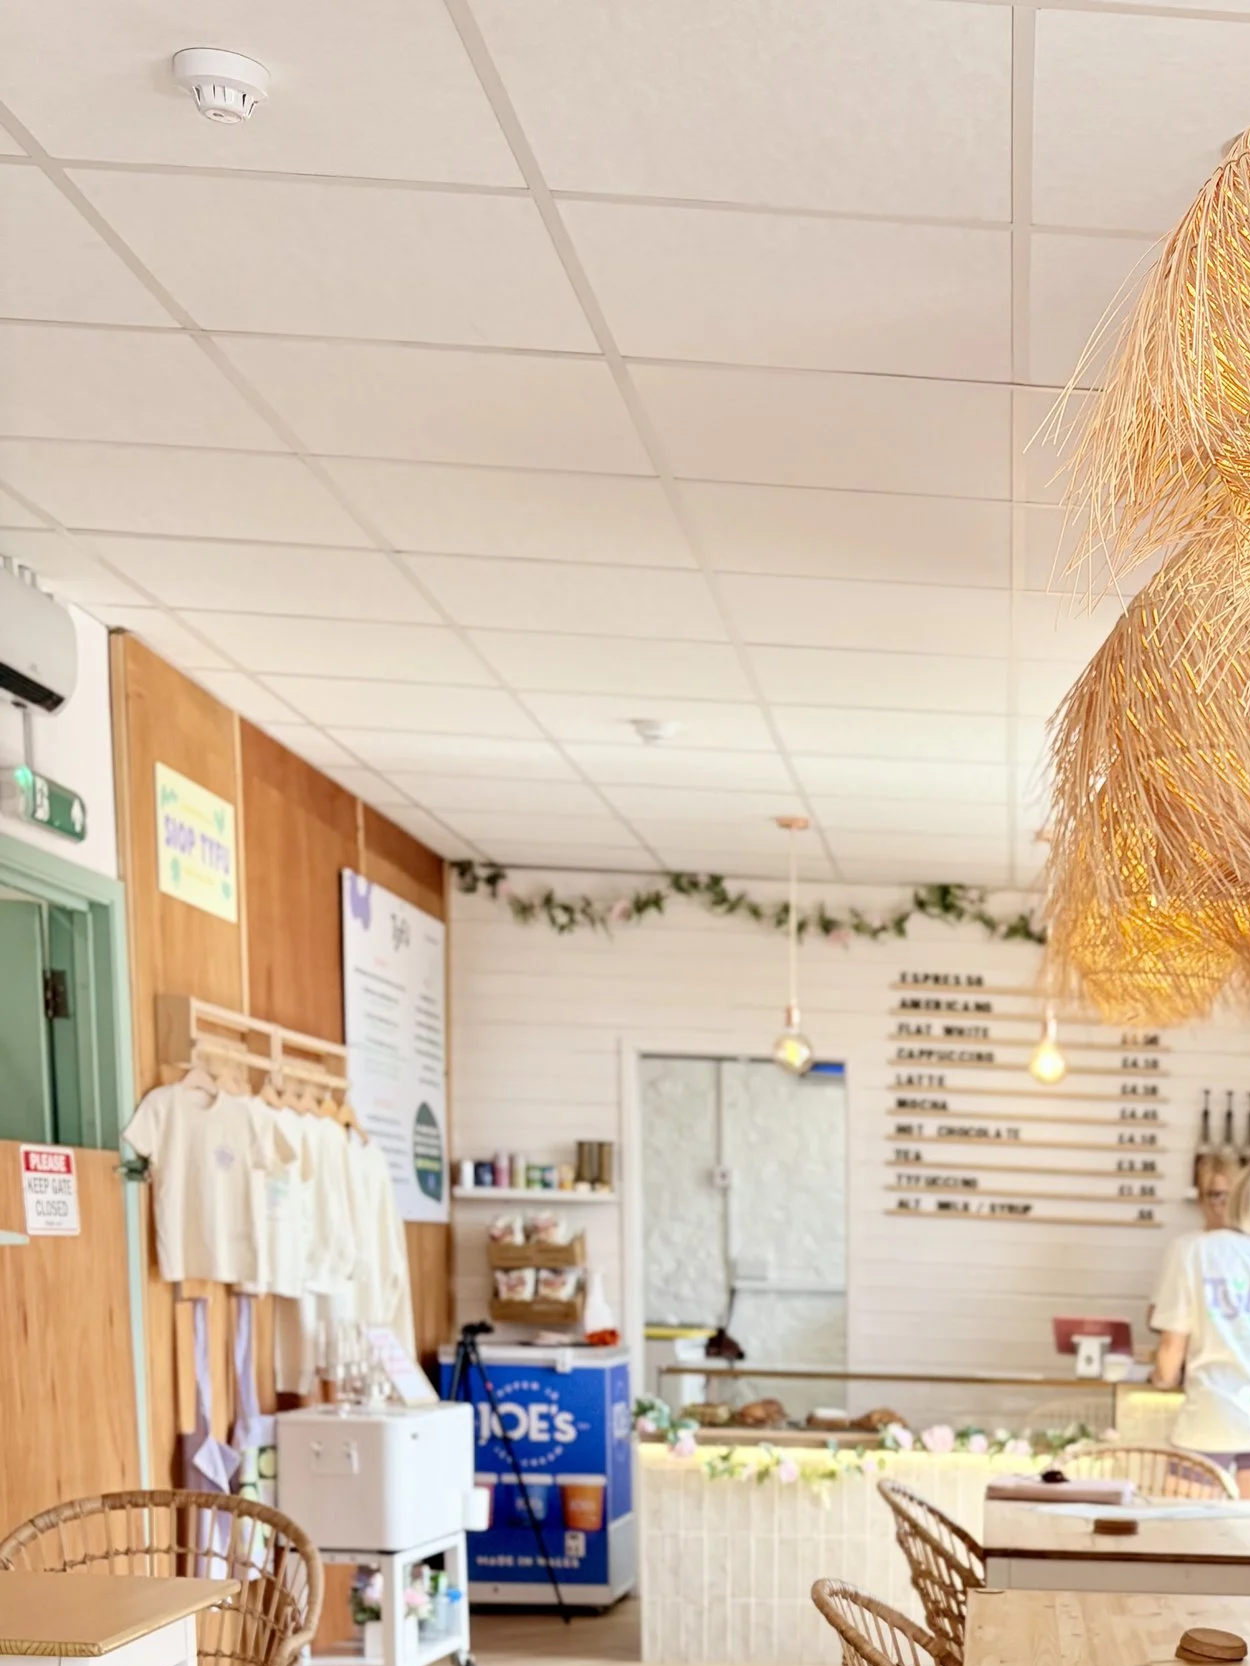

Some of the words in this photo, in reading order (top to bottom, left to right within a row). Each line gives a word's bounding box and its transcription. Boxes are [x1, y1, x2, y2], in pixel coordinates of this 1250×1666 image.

[900, 998, 991, 1013] AMERICANO
[898, 1022, 931, 1036] FLAT
[944, 1025, 988, 1040] WHITE
[897, 1047, 994, 1063] CAPPUCCINO
[895, 1074, 944, 1088] LATTE
[896, 1097, 948, 1111] MOCHA
[896, 1123, 923, 1137] HOT
[937, 1125, 1019, 1141] CHOCOLATE
[30, 1152, 66, 1172] PLEASE
[895, 1148, 921, 1162] TEA
[27, 1176, 49, 1195] KEEP
[52, 1178, 72, 1196] GATE
[35, 1200, 69, 1217] CLOSED
